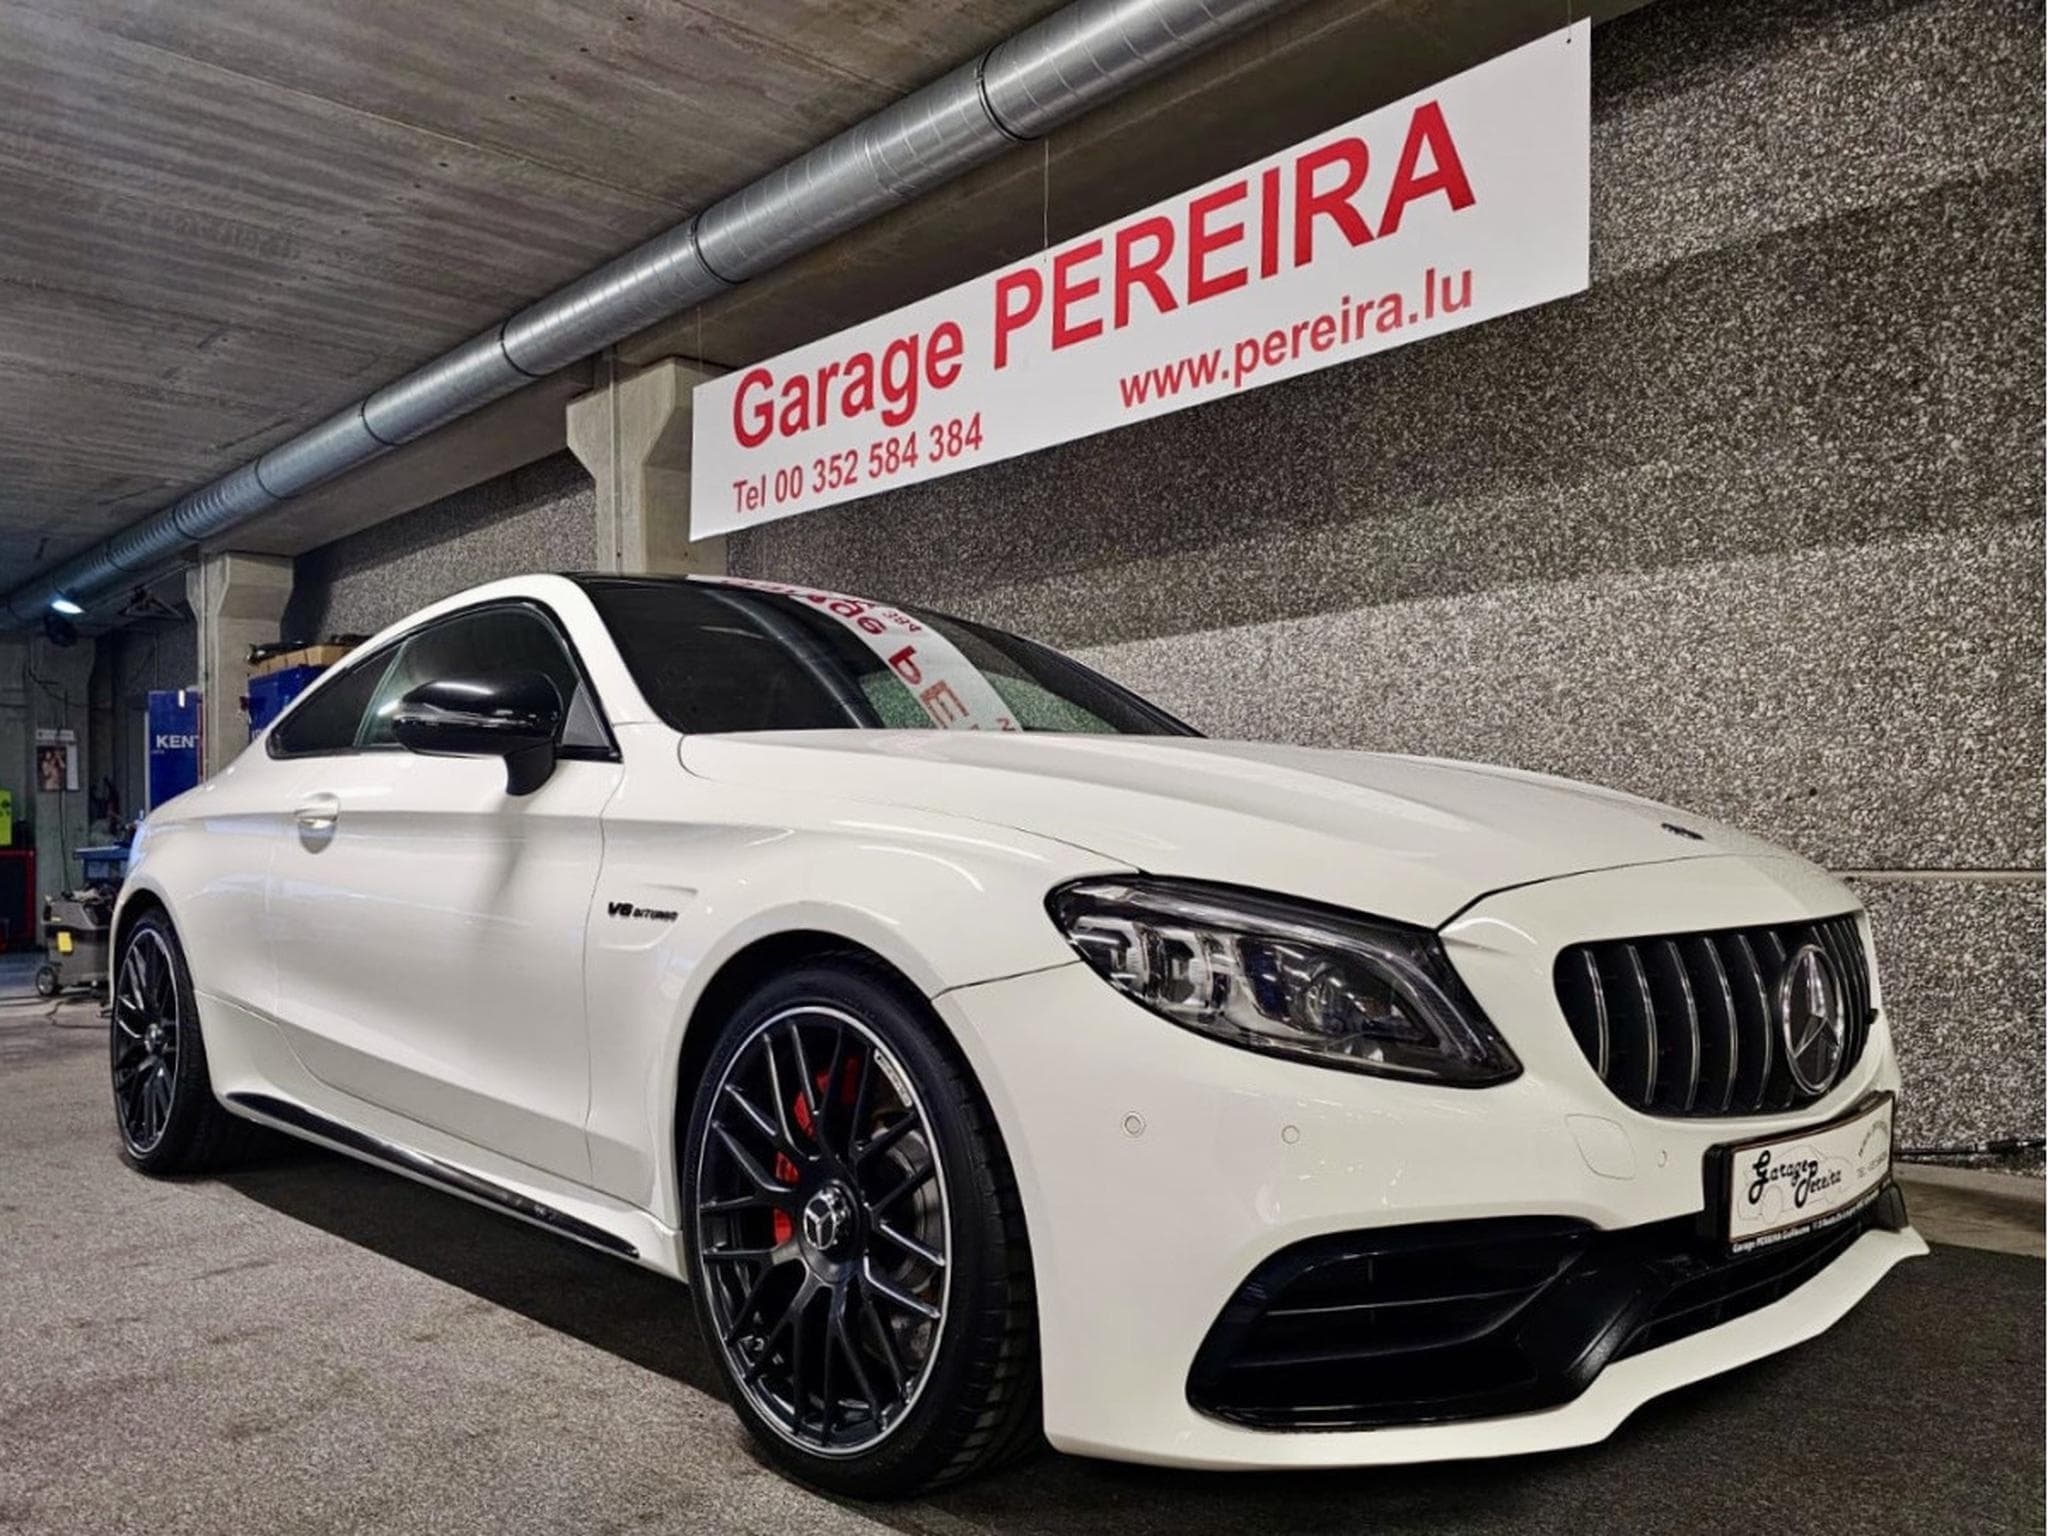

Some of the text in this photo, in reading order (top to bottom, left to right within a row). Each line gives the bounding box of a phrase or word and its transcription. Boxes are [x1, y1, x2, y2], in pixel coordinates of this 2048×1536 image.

[732, 100, 1476, 449] Garage PEREIRA
[1119, 269, 1473, 408] www.pereira.lu
[733, 412, 983, 513] Tel 00 352 584 384
